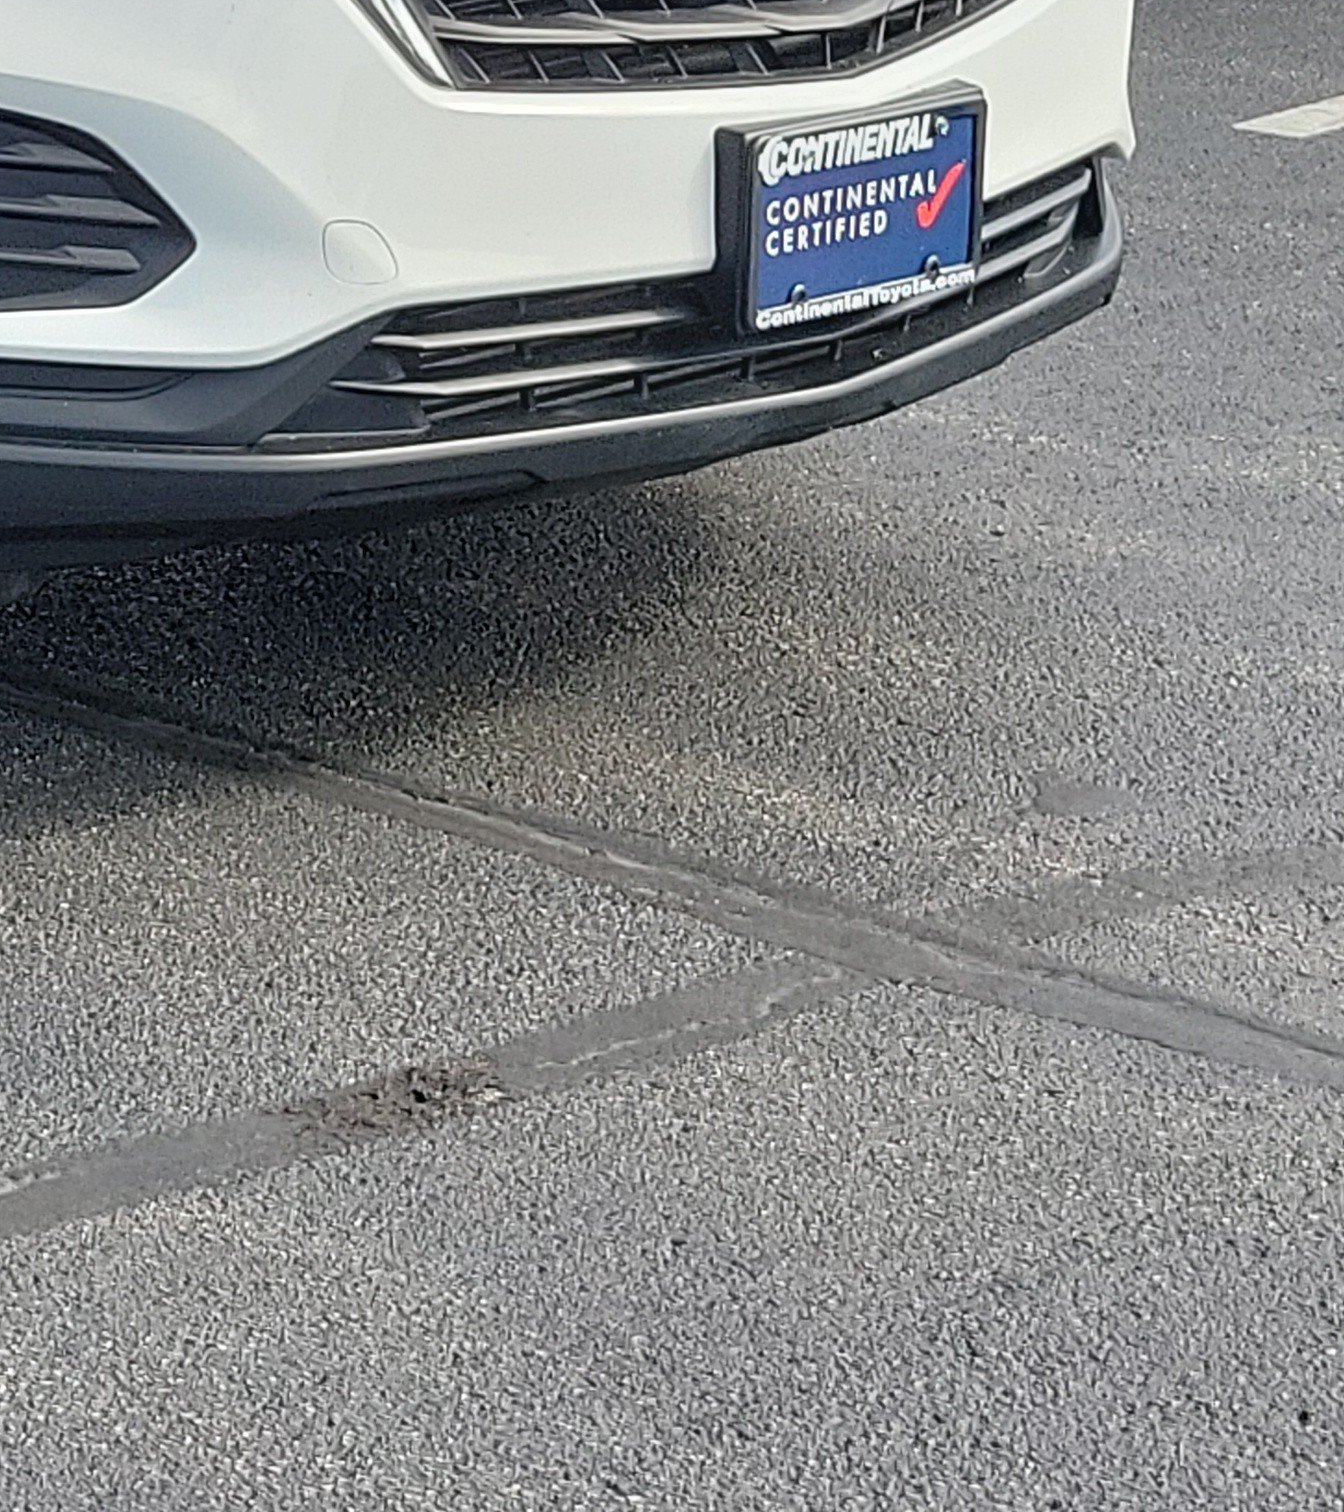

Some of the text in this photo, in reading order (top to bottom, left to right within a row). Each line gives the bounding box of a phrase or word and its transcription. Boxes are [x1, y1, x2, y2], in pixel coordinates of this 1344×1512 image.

[757, 113, 934, 187] CONTINENTAL
[765, 169, 937, 225] CONTINENTAL
[765, 209, 888, 257] CERTIFIED
[755, 268, 976, 330] ContinentalToyota.com
